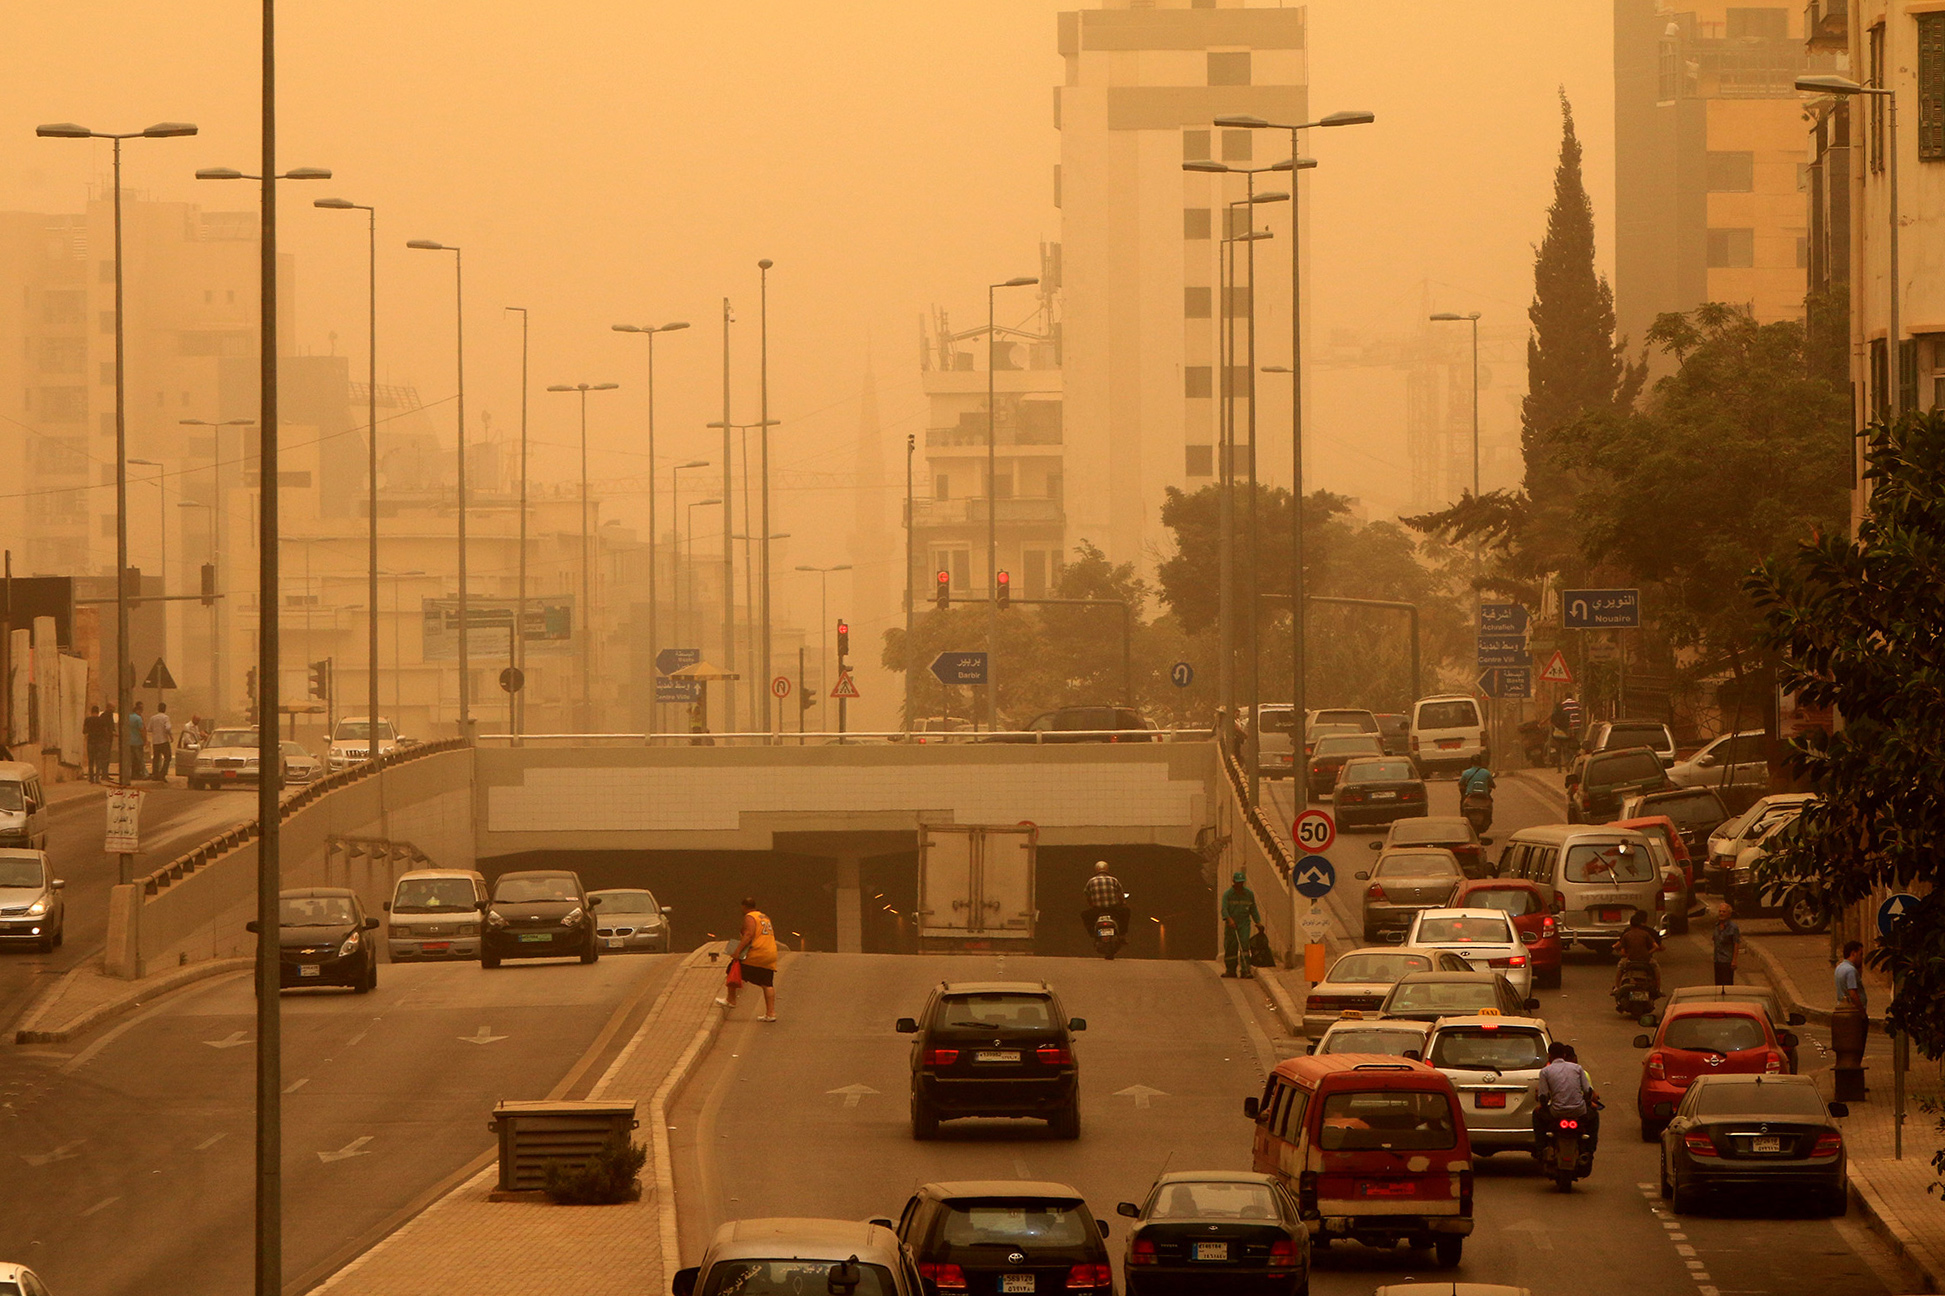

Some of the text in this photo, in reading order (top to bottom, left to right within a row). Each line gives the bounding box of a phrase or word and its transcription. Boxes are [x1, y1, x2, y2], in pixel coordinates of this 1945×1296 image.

[1592, 595, 1635, 610] النويري
[956, 657, 981, 667] بربير
[1300, 822, 1328, 842] 50
